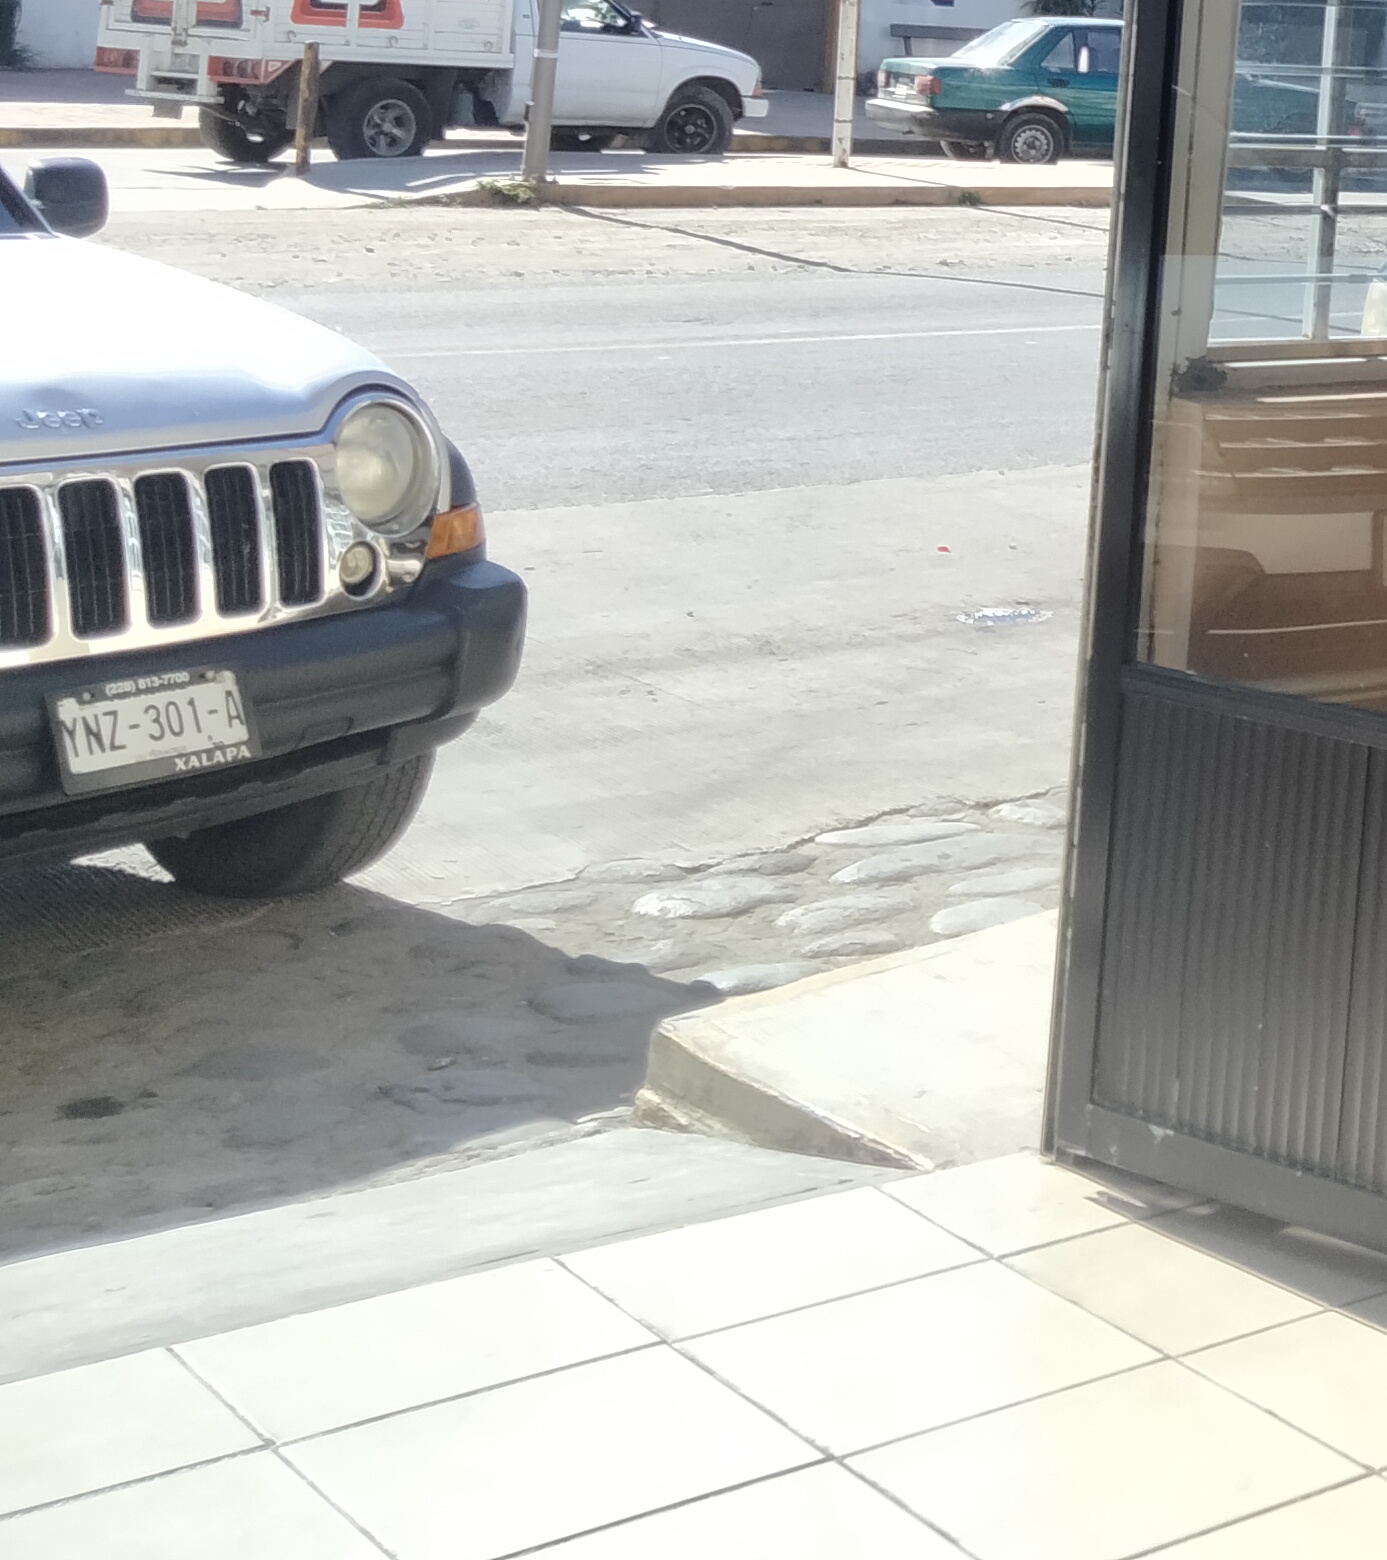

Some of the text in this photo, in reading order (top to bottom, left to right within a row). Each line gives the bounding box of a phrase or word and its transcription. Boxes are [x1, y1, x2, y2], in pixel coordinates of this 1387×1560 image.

[15, 408, 104, 430] Jeep
[60, 690, 246, 758] YNZ-301-A
[174, 744, 252, 772] XALAPA
